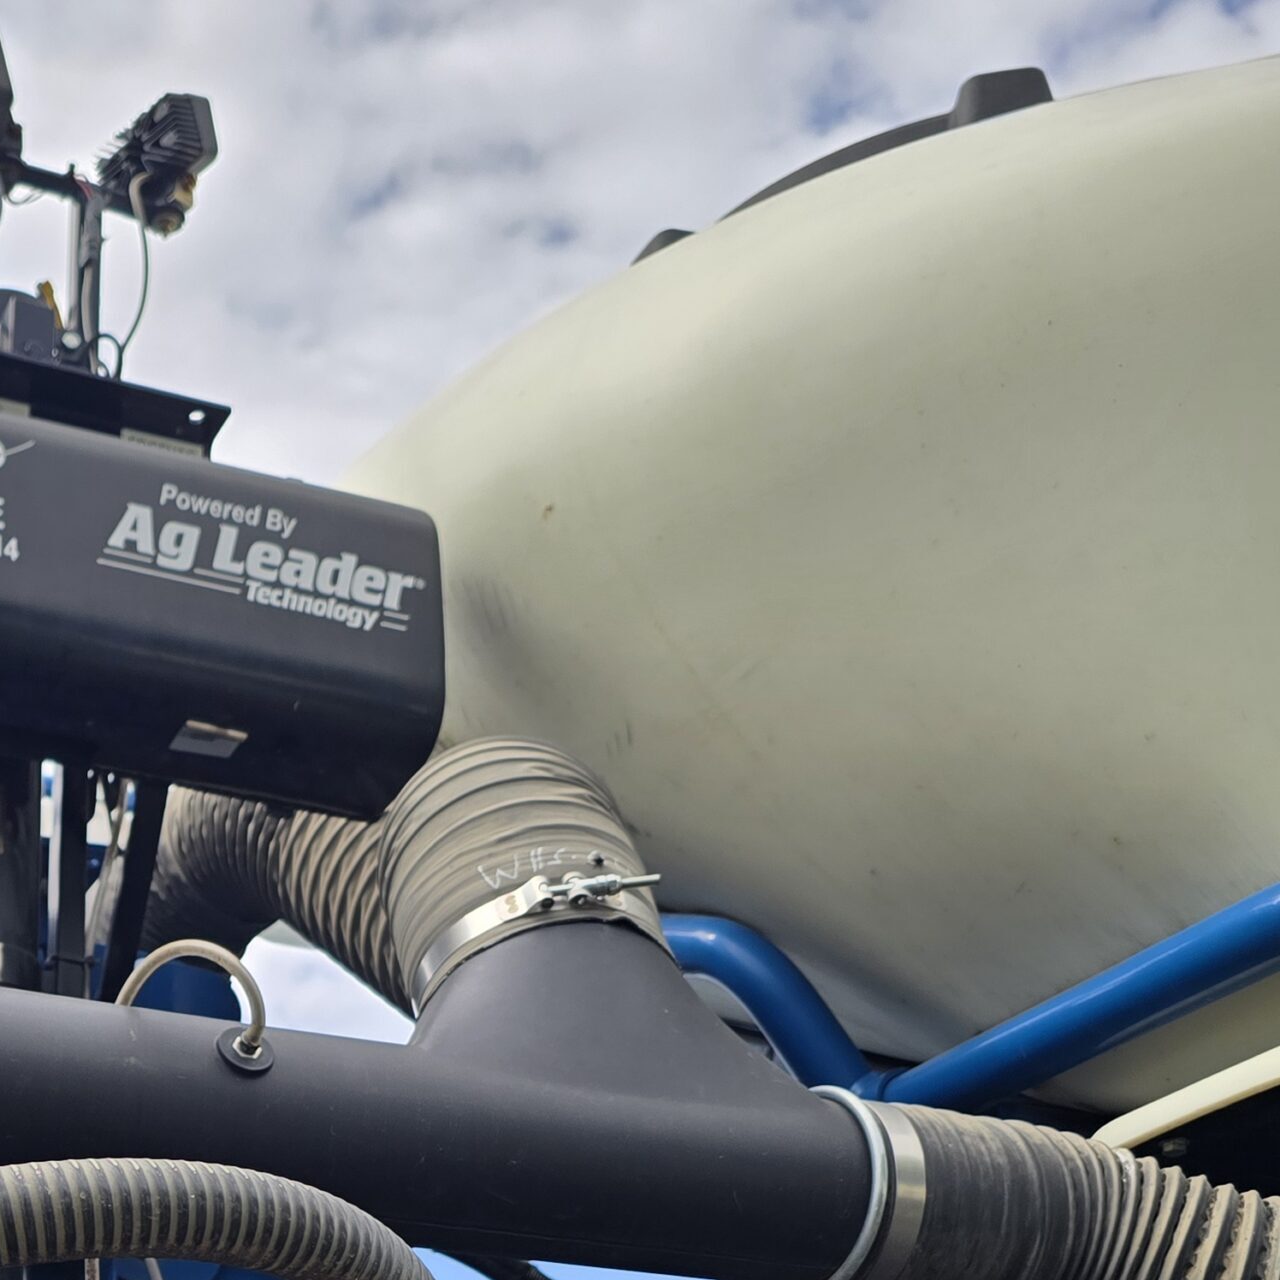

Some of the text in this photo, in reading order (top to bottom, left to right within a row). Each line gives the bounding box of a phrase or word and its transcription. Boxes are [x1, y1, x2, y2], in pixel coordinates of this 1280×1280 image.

[160, 483, 298, 539] Powered By
[107, 502, 413, 611] Ag Leader
[246, 580, 380, 632] Technology
